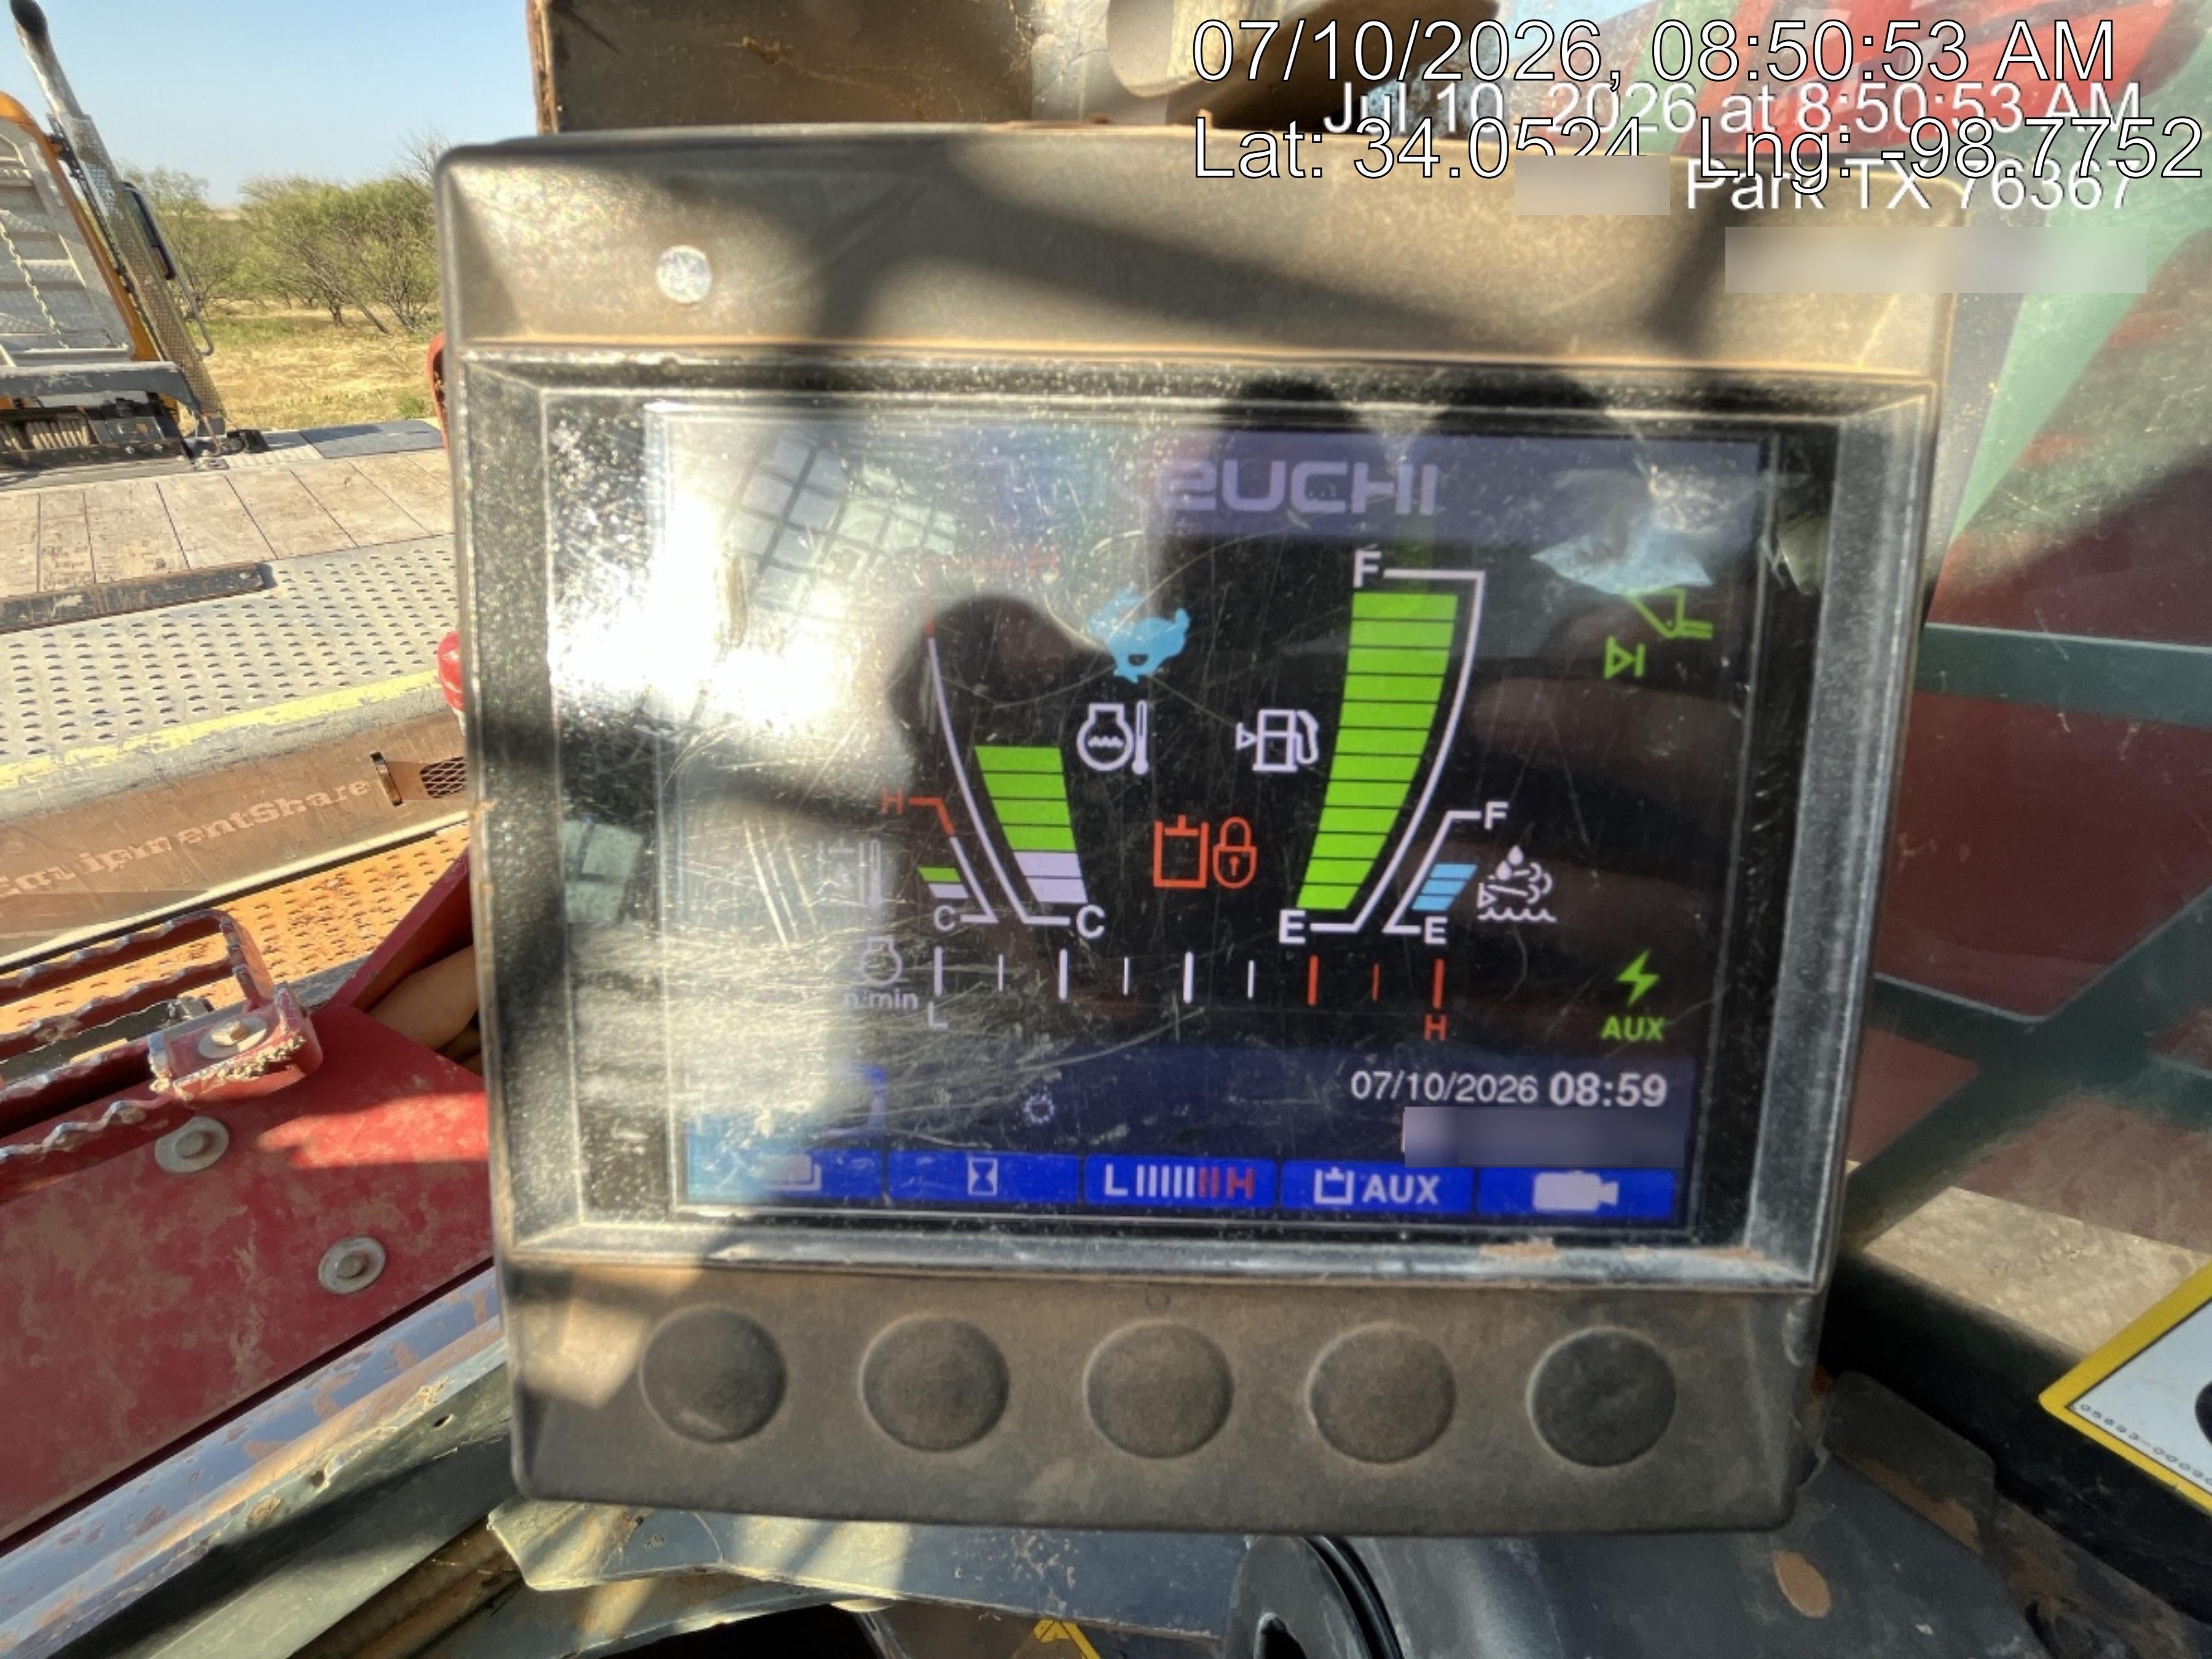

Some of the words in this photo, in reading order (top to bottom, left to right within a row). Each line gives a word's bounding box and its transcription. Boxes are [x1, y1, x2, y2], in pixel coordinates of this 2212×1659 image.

[1354, 551, 1382, 589] F
[880, 786, 904, 814] H
[1484, 801, 1509, 830] F
[933, 905, 956, 931] C
[1077, 904, 1105, 938] C
[1279, 910, 1306, 944] E
[1424, 917, 1448, 945] E
[928, 1001, 948, 1029] L
[1424, 1014, 1447, 1040] H
[1601, 1016, 1665, 1041] AUX
[1351, 1070, 1538, 1104] 07/10/2026
[1548, 1071, 1668, 1108] 08:59
[1362, 1174, 1441, 1205] AUX
